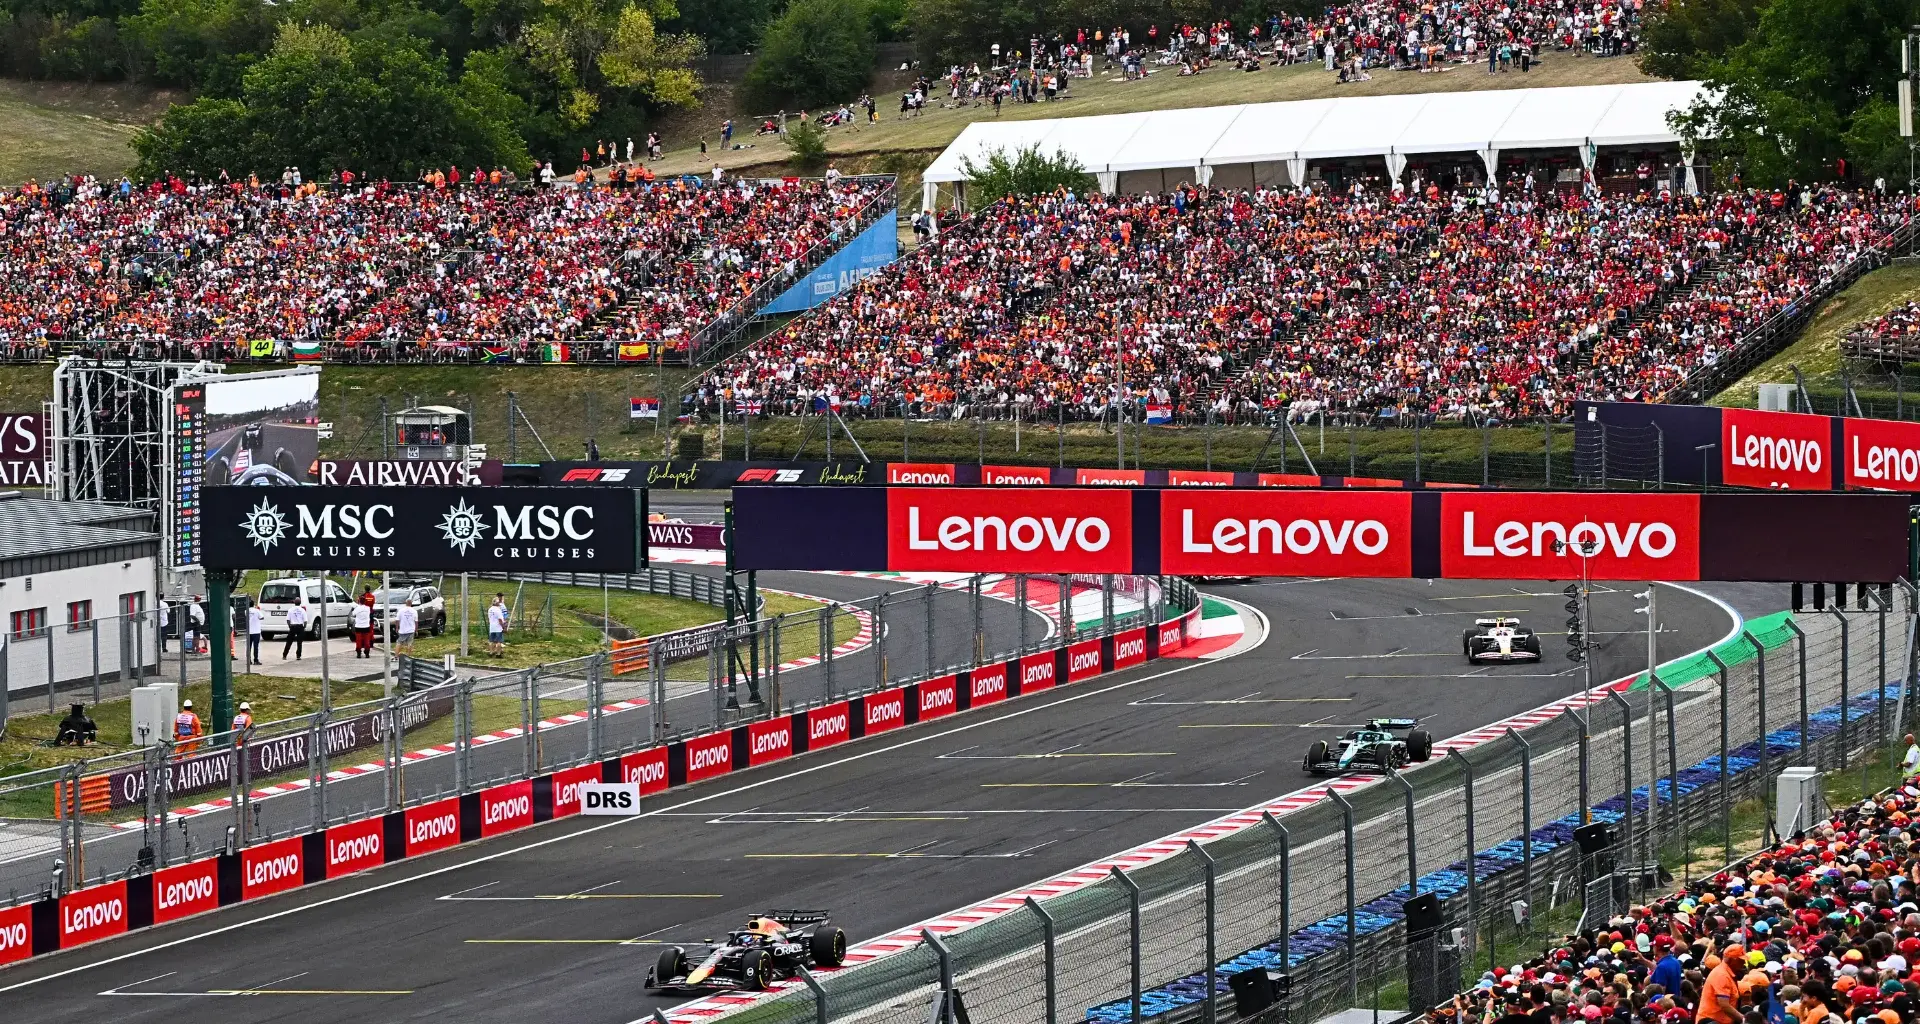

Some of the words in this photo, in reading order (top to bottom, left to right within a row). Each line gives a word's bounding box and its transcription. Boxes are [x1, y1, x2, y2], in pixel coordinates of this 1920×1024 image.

[255, 342, 269, 352] 44
[1732, 425, 1821, 473] Lenovo
[1853, 435, 1920, 482] Leno
[647, 462, 699, 489] Budapest
[820, 464, 867, 484] Budapest
[893, 470, 950, 484] Lenovo
[296, 504, 394, 539] MSC
[493, 505, 594, 540] MSC
[909, 507, 1110, 552] Lenovo
[1183, 509, 1388, 555] Lenovo
[648, 526, 693, 544] WAYS
[1464, 511, 1676, 558] Lenovo
[296, 546, 395, 556] CRUISES
[494, 548, 594, 558] CRUISES
[1160, 628, 1179, 646] Lenovo
[1071, 651, 1098, 672] Lenovo
[1116, 639, 1143, 660] Lenovo
[1023, 663, 1052, 684] Lenovo
[973, 675, 1003, 697] Lenovo
[922, 688, 953, 711] Lenovo
[868, 701, 900, 724] Lenovo
[811, 715, 845, 739] Lenovo
[261, 737, 304, 771] QATAR
[308, 722, 356, 758] IWAYS
[752, 730, 788, 754] Lenovo
[690, 745, 728, 770] Lenovo
[124, 768, 173, 802] QAAR
[178, 755, 233, 791] AIRWAY
[625, 761, 664, 784] Lenovo
[485, 796, 528, 824] Lenovo
[587, 792, 632, 808] DRS
[410, 814, 455, 843] Lenovo
[331, 834, 379, 864] Lenovo
[247, 854, 298, 886] Lenovo
[159, 876, 212, 909] Lenovo
[65, 899, 122, 933] Lenovo
